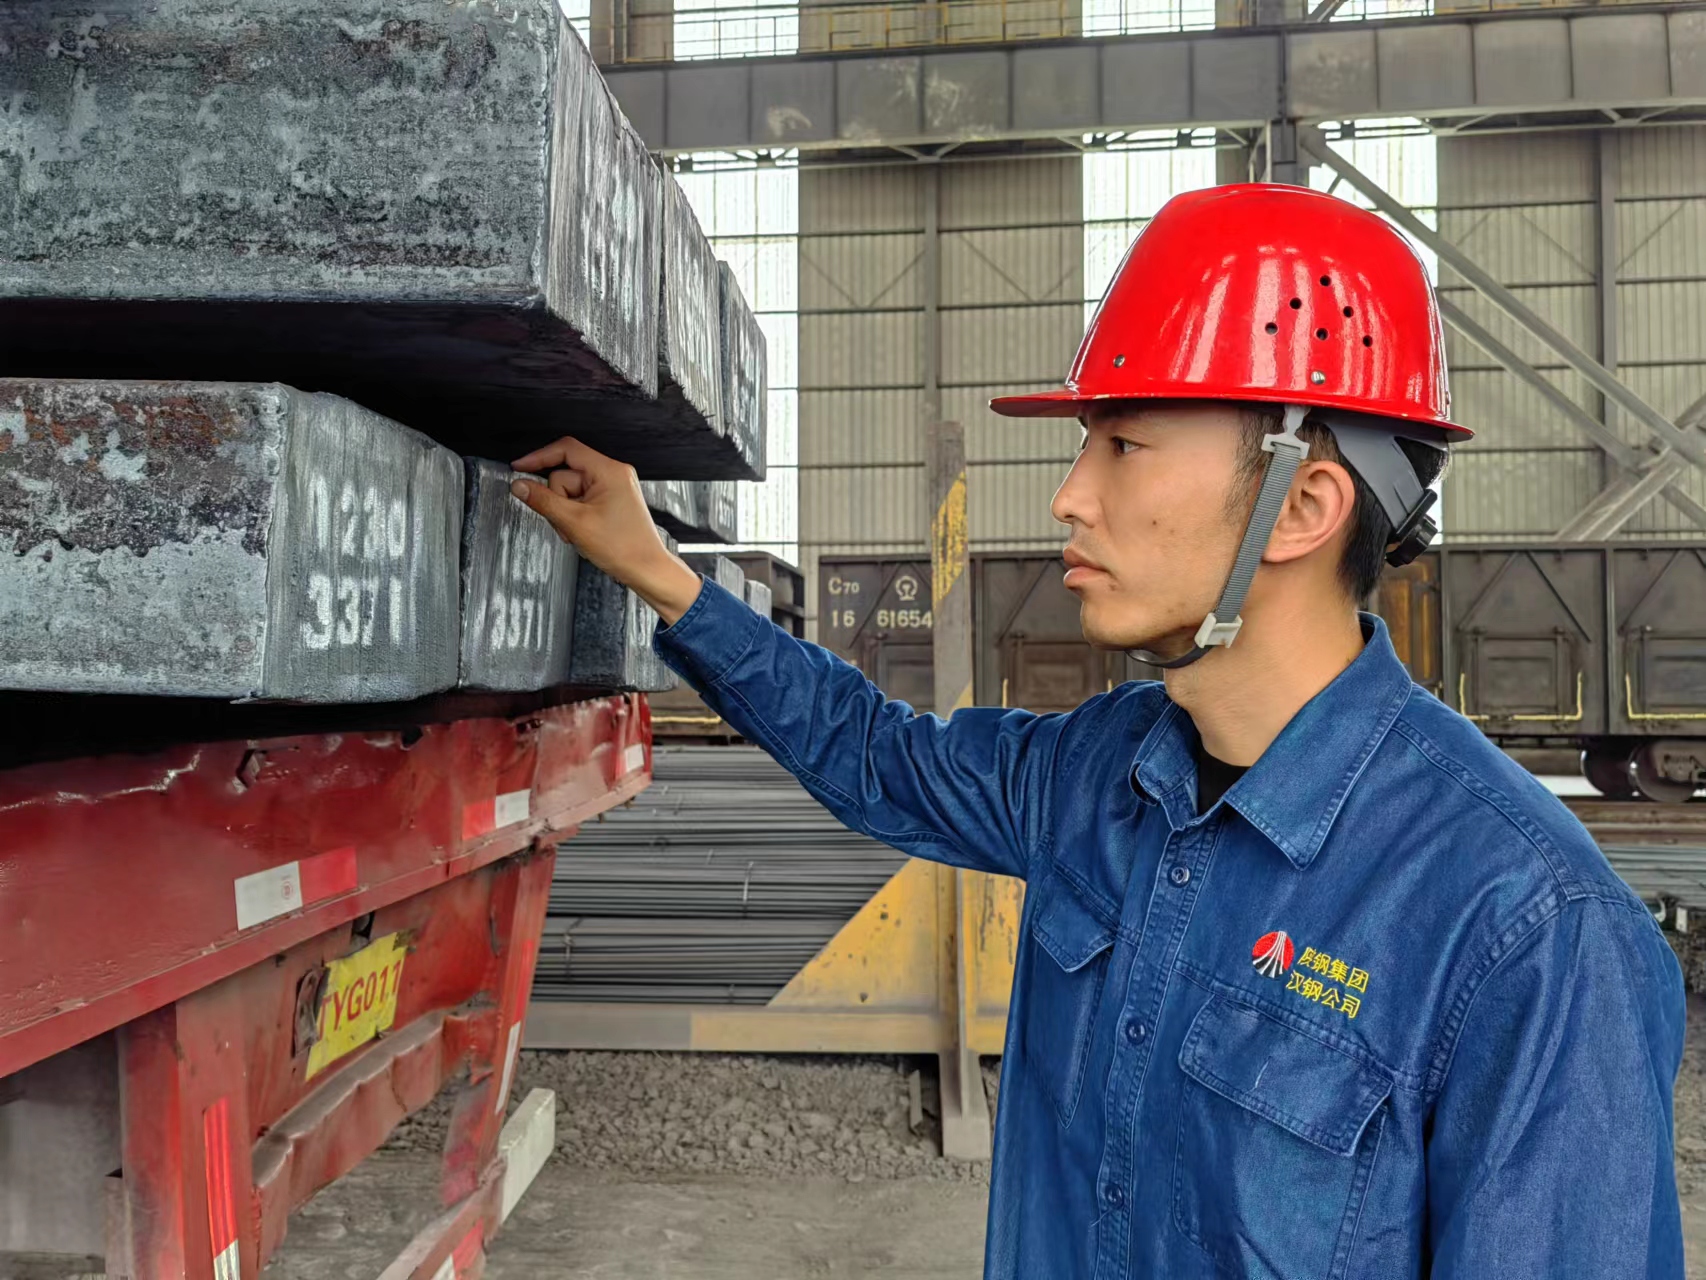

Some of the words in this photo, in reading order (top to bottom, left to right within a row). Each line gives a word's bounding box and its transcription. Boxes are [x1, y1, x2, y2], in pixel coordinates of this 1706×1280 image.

[828, 577, 860, 595] C70
[301, 574, 402, 650] 3371
[490, 592, 543, 650] 3371
[832, 610, 855, 628] 16
[877, 610, 934, 628] 61654
[1297, 946, 1370, 993] 陕钢集团
[1285, 969, 1361, 1019] 汉钢公司
